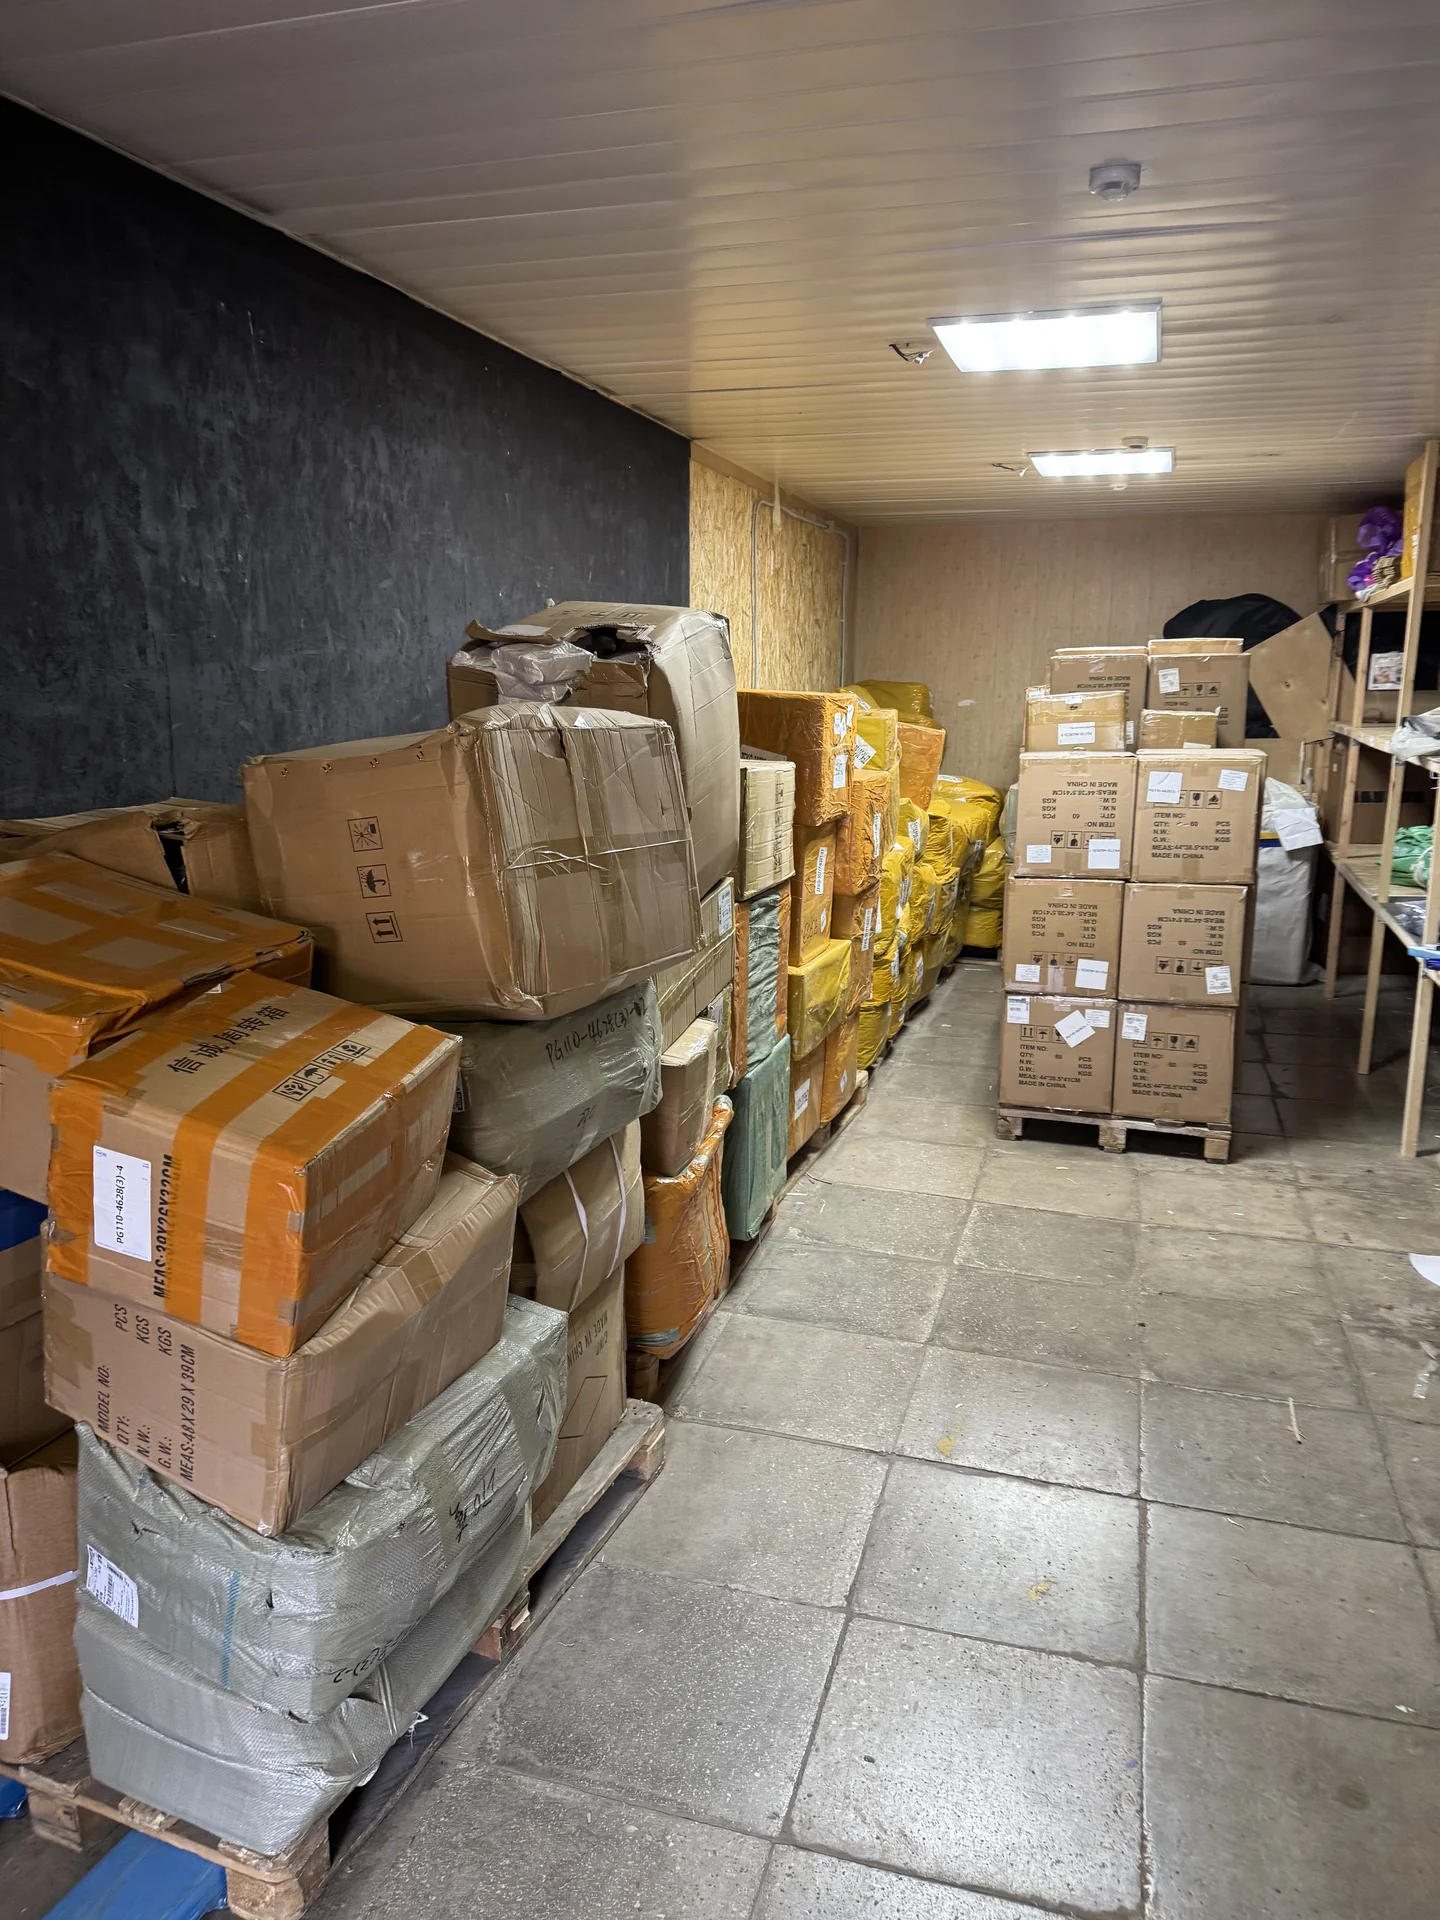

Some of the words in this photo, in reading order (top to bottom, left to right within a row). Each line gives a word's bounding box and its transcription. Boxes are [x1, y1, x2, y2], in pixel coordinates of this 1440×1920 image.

[167, 1005, 291, 1076] 信诚周转箱
[115, 1165, 126, 1245] PG110-4628(3)-4
[114, 1303, 129, 1332] PCS
[135, 1315, 150, 1345] KGS
[592, 1310, 608, 1338] MADE
[157, 1327, 173, 1356] KGS
[584, 1330, 593, 1348] IN
[567, 1341, 583, 1368] CHIN
[97, 1365, 110, 1388] NO:
[98, 1391, 110, 1433] MODEL
[117, 1416, 130, 1445] QTY:
